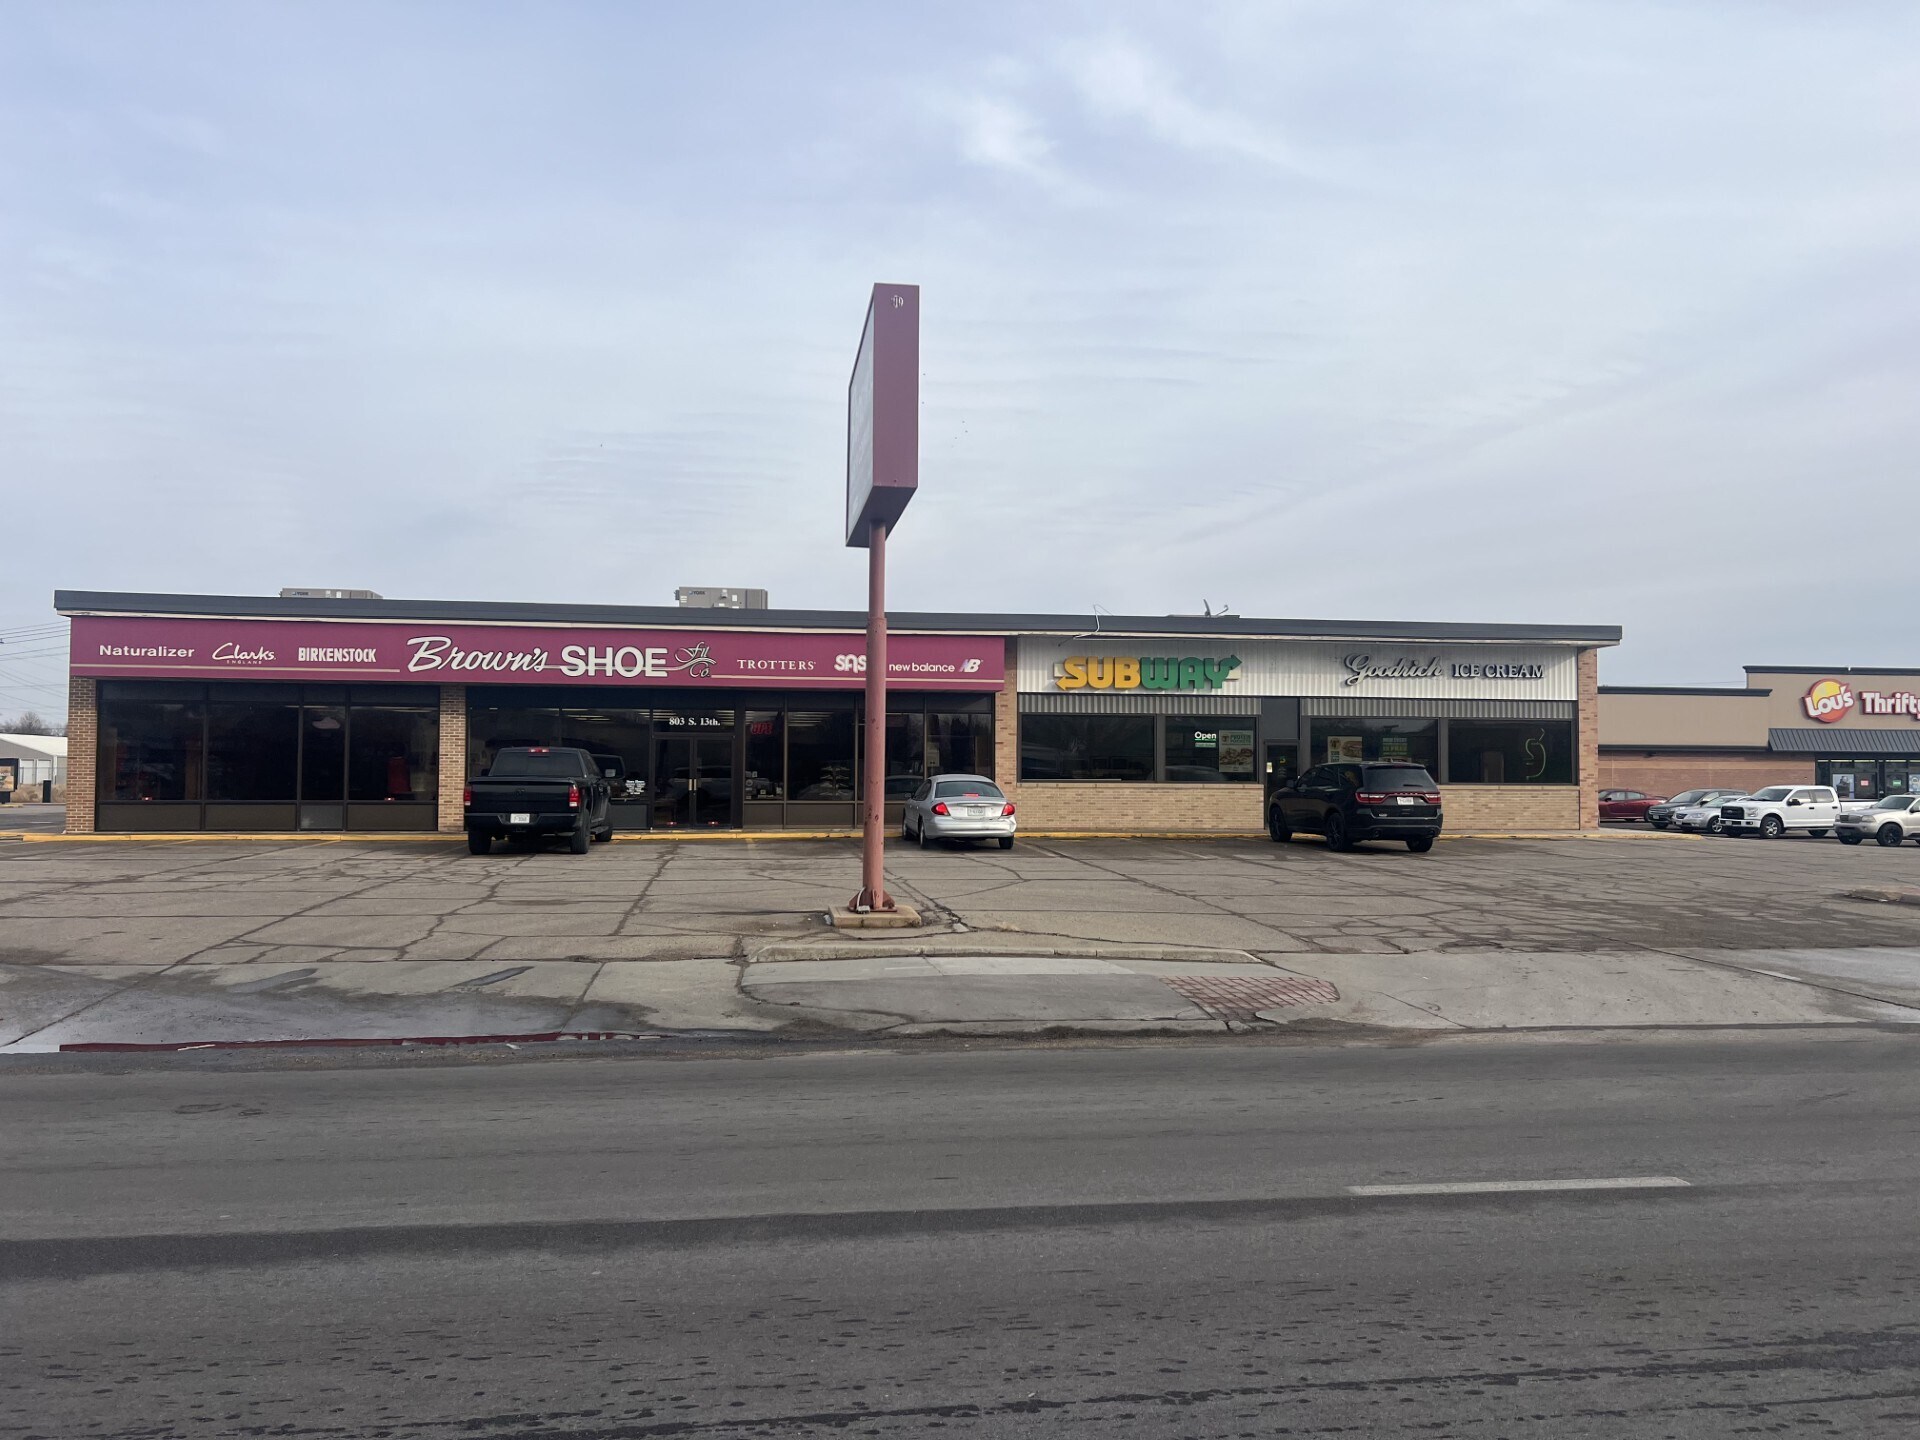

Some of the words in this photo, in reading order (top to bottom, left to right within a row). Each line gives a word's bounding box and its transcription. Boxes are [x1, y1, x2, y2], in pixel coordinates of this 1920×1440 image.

[99, 644, 195, 658] Naturalizer
[211, 642, 276, 661] Clarks
[298, 647, 377, 662] BIRKENSTOCK
[406, 636, 549, 673] Brown's
[560, 645, 668, 678] SHOE
[737, 659, 815, 671] TROTTERS
[888, 663, 911, 672] new
[912, 662, 955, 673] balance
[1344, 653, 1443, 687] Goodrich
[1453, 663, 1481, 678] ICE
[1484, 663, 1546, 679] CREAM
[1055, 654, 1242, 691] SUBWAY
[669, 717, 685, 726] 803
[688, 717, 697, 726] S.
[1194, 731, 1217, 740] Open
